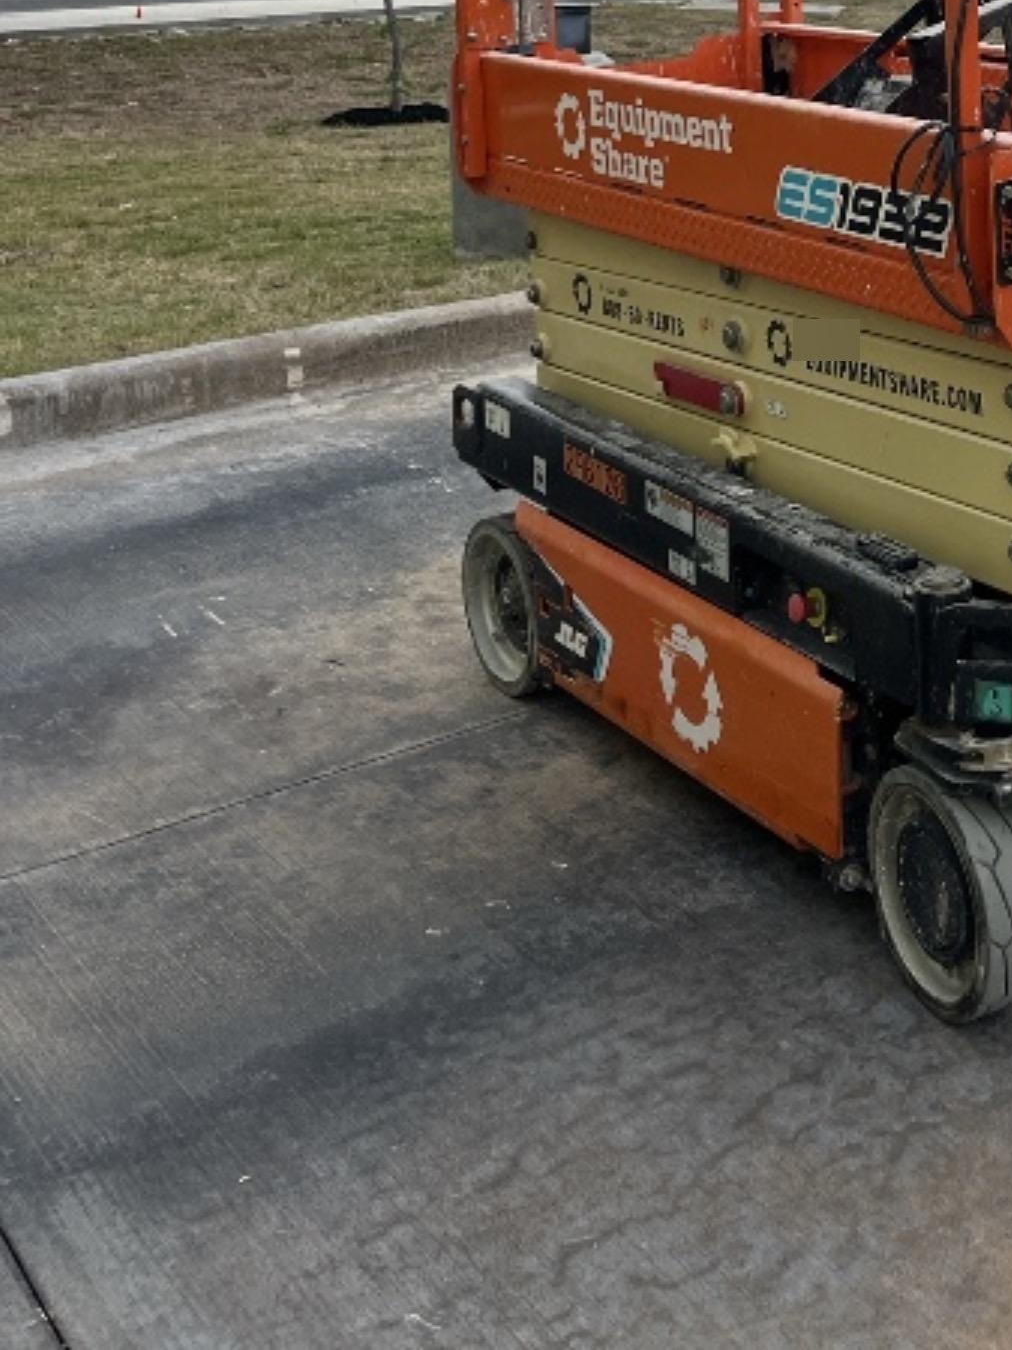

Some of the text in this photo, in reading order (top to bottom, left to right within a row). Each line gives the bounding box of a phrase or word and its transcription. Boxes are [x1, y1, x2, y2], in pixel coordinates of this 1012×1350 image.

[587, 89, 733, 154] Equipment
[589, 138, 666, 189] Share
[776, 166, 953, 259] ES1932
[554, 620, 588, 658] JLG
